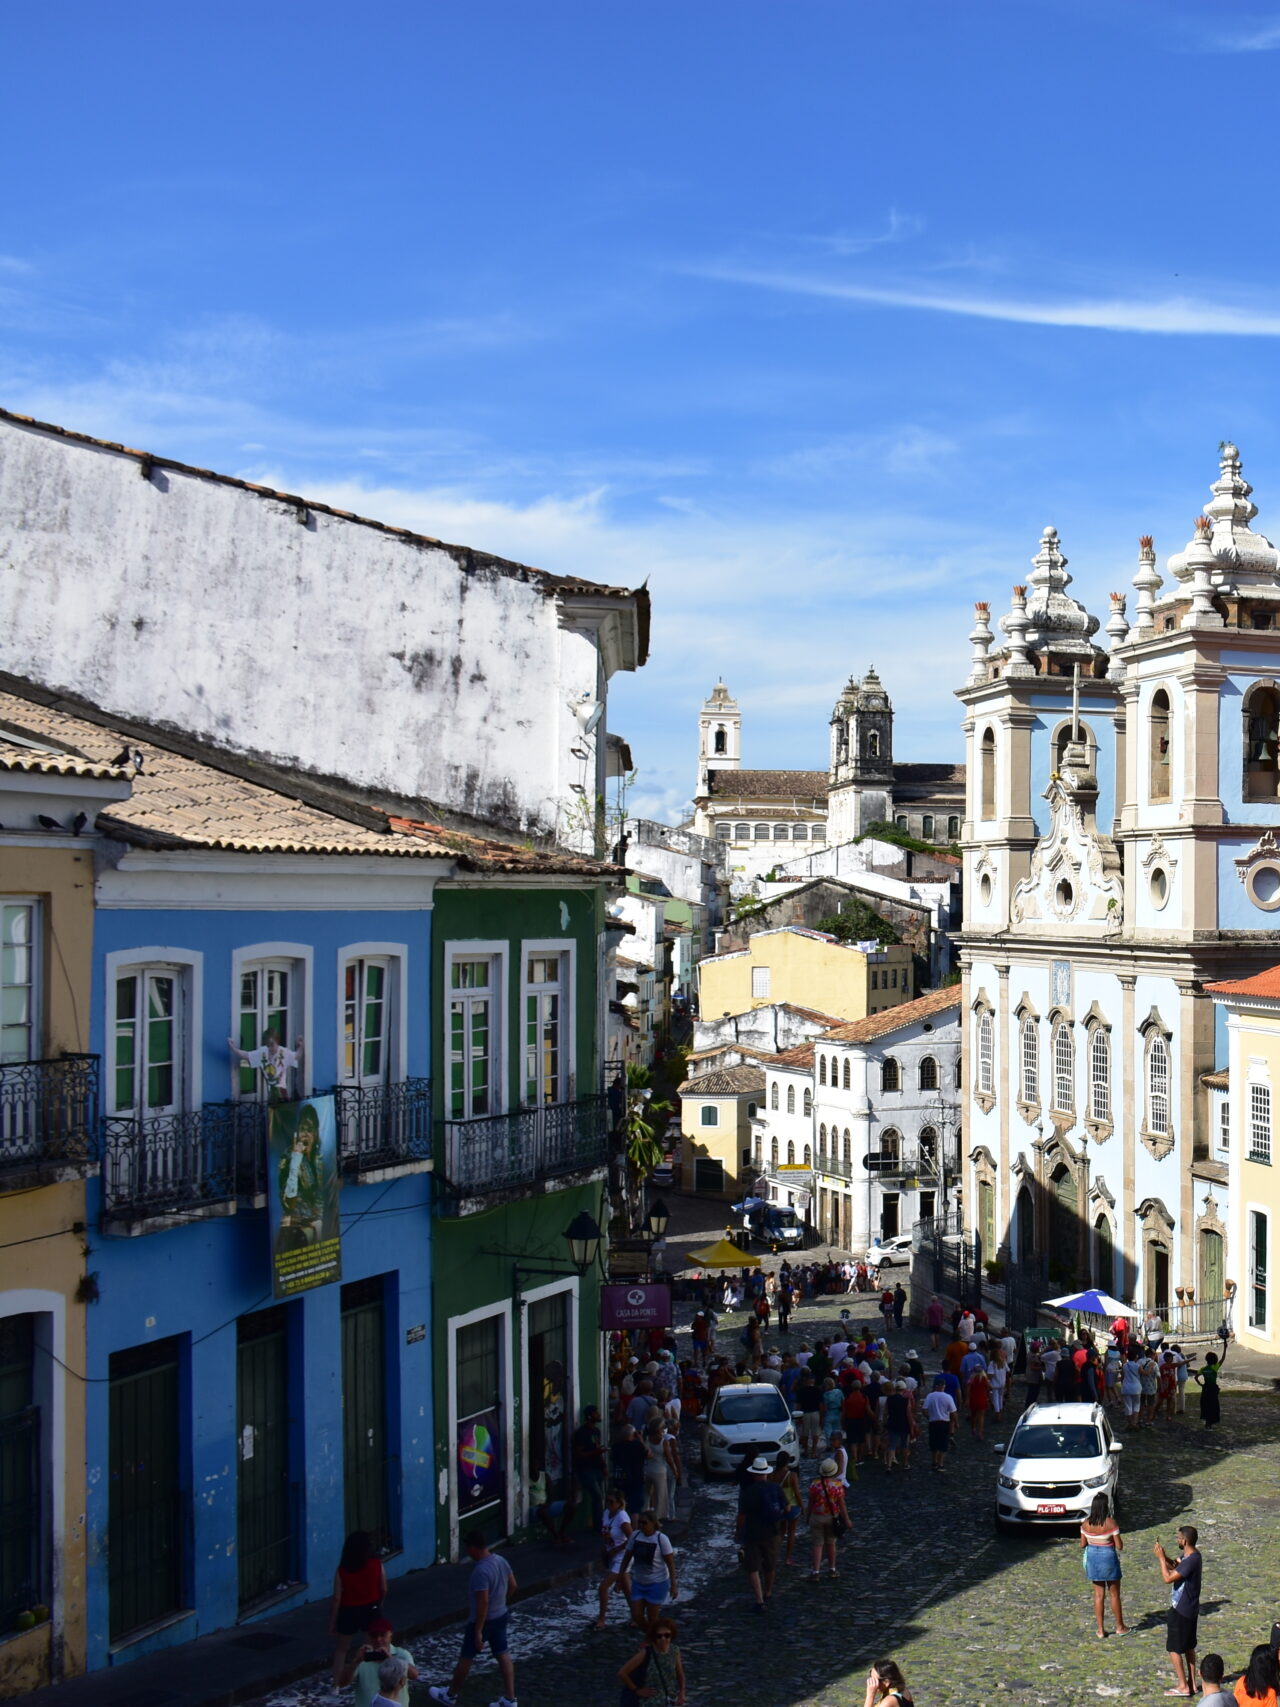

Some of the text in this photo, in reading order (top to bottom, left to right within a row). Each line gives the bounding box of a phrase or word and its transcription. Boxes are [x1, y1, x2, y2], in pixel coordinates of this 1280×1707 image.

[616, 1308, 657, 1318] CASA DA PONTE
